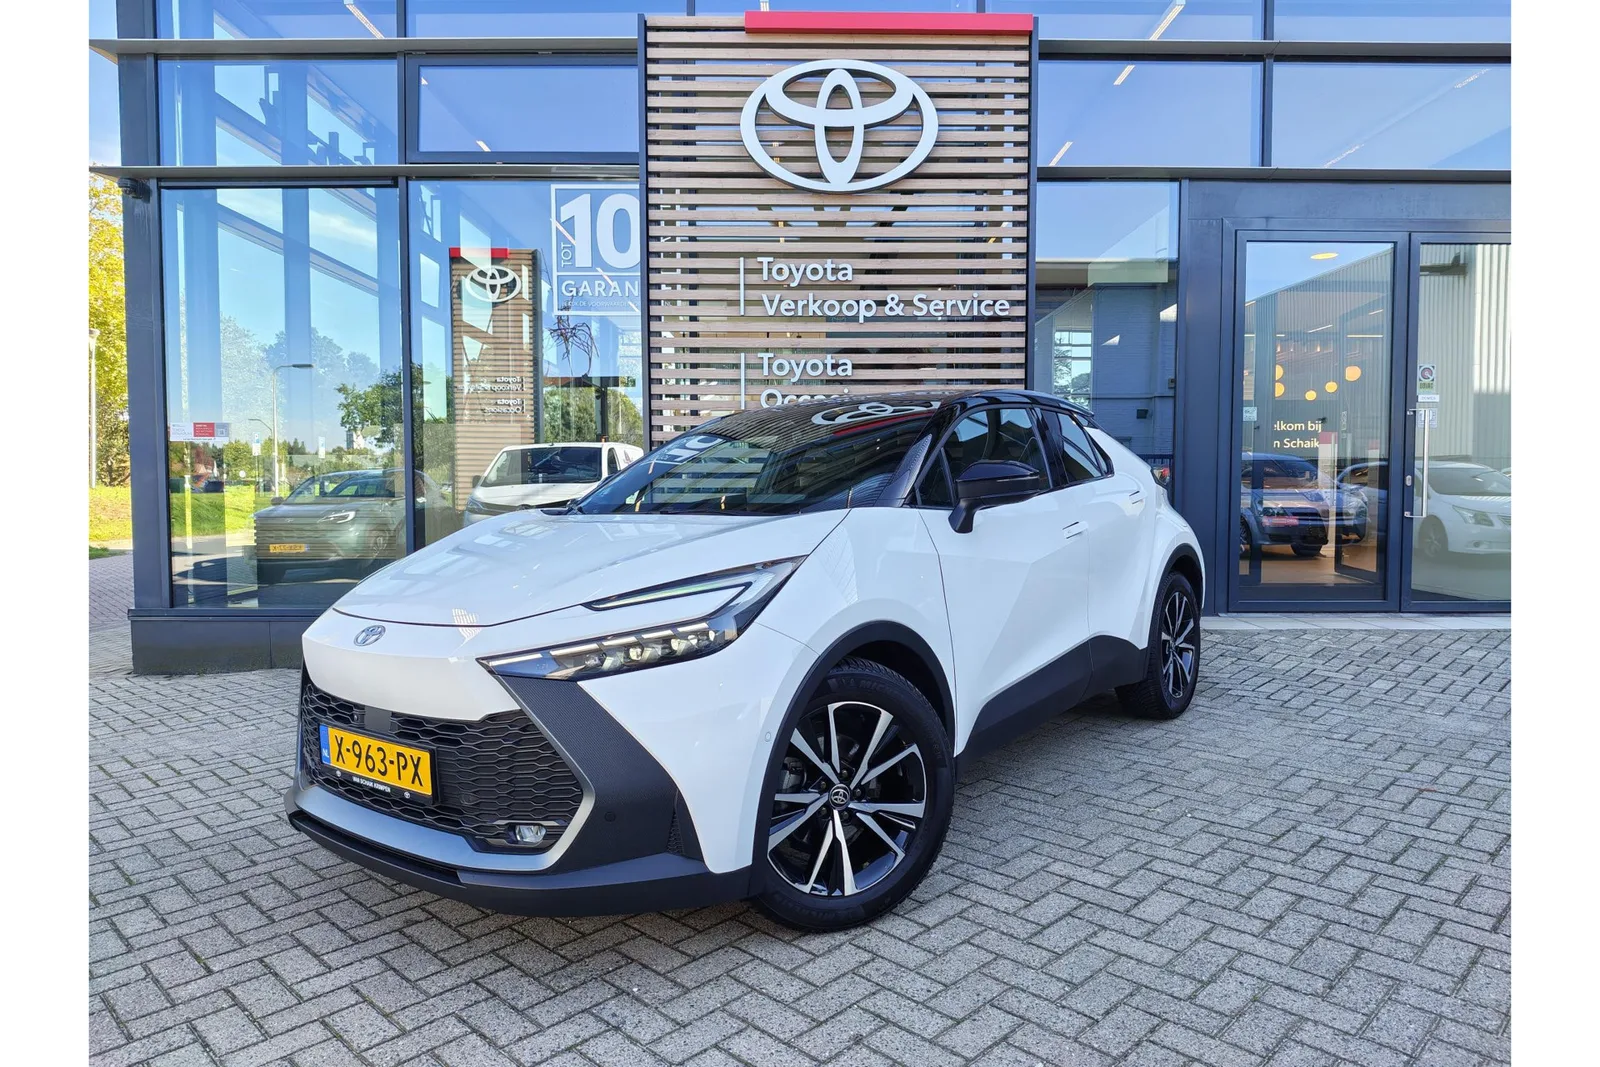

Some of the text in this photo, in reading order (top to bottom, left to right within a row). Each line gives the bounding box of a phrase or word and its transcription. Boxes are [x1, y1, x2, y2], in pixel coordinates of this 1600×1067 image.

[560, 193, 640, 269] 10
[561, 242, 572, 267] TOT
[757, 257, 853, 287] Toyota
[561, 280, 640, 297] GARAN
[761, 293, 1010, 323] Verkoop & Service
[757, 353, 853, 382] Toyota
[1307, 420, 1322, 433] bij
[1283, 438, 1320, 448] Schaik
[334, 734, 424, 787] X-963-PX
